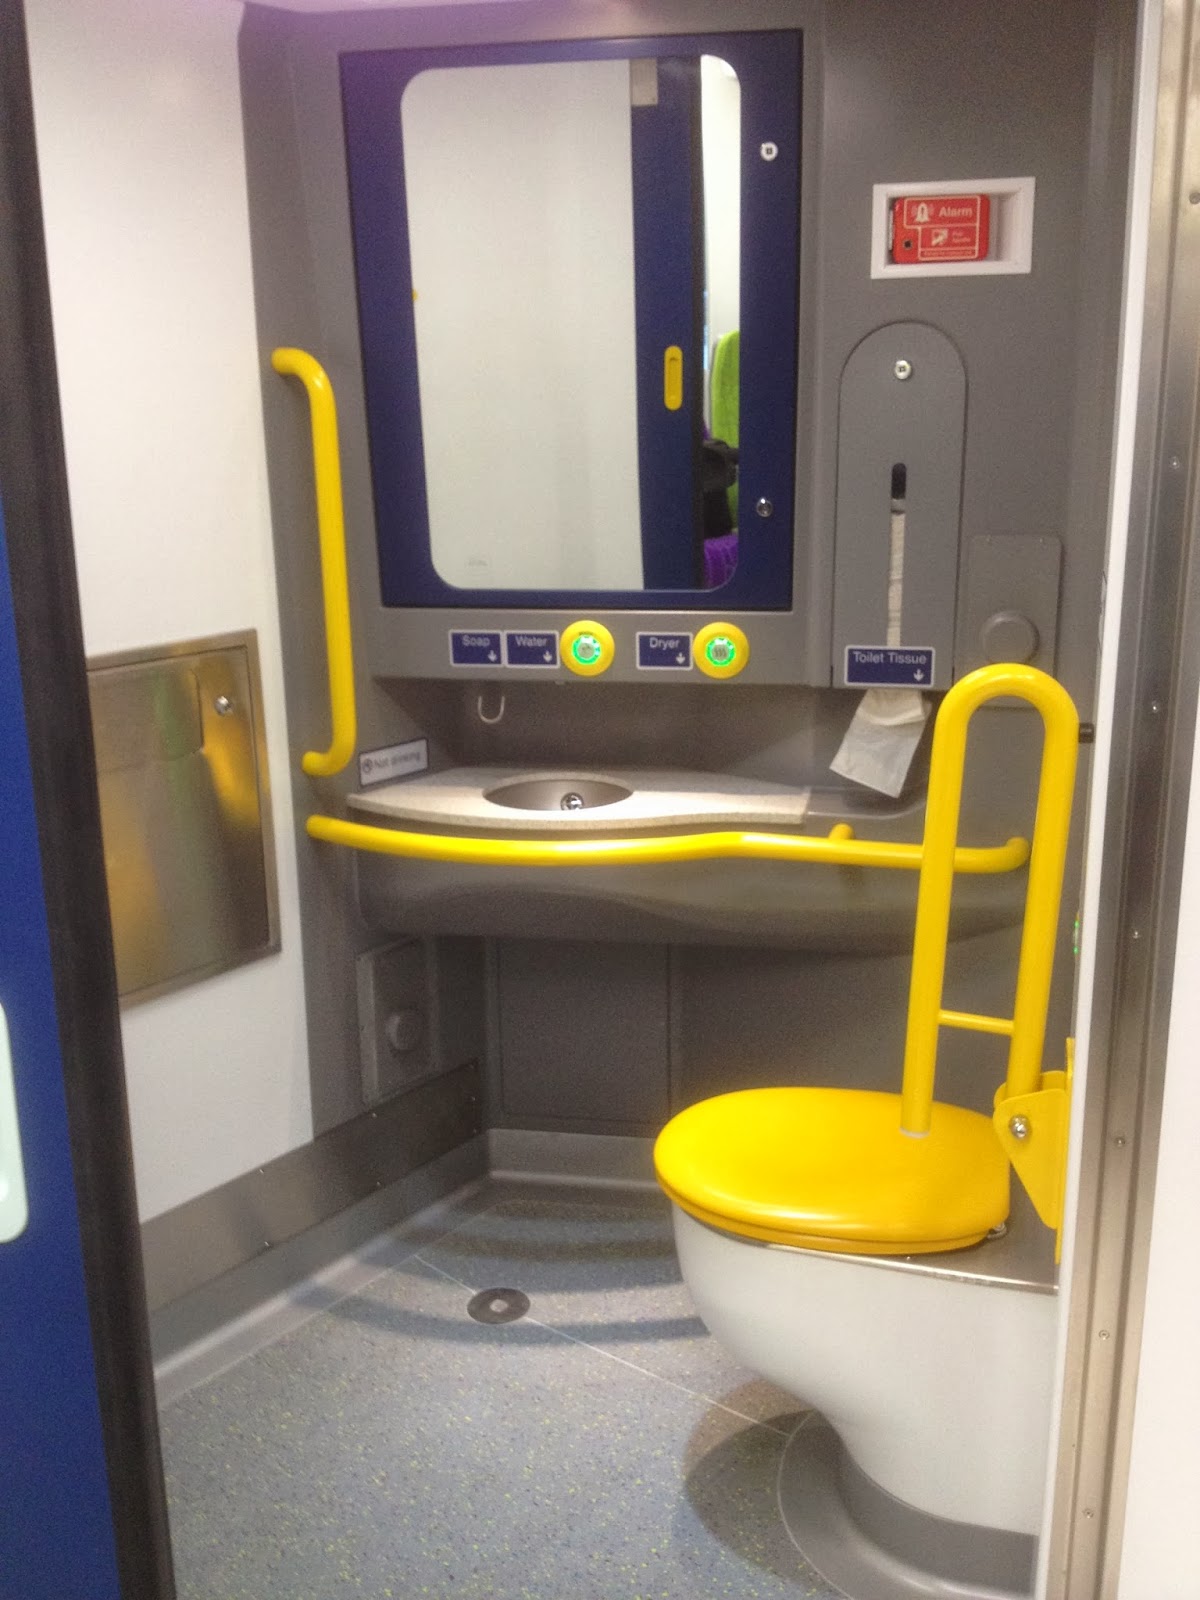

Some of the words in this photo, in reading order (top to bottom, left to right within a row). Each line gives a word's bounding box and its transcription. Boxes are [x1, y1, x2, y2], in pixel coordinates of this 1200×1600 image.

[938, 205, 973, 218] Alarm
[462, 635, 490, 649] Soap
[515, 635, 547, 647] Water
[650, 637, 680, 650] Dryer
[852, 651, 884, 664] Toilet
[887, 651, 927, 664] Tissue
